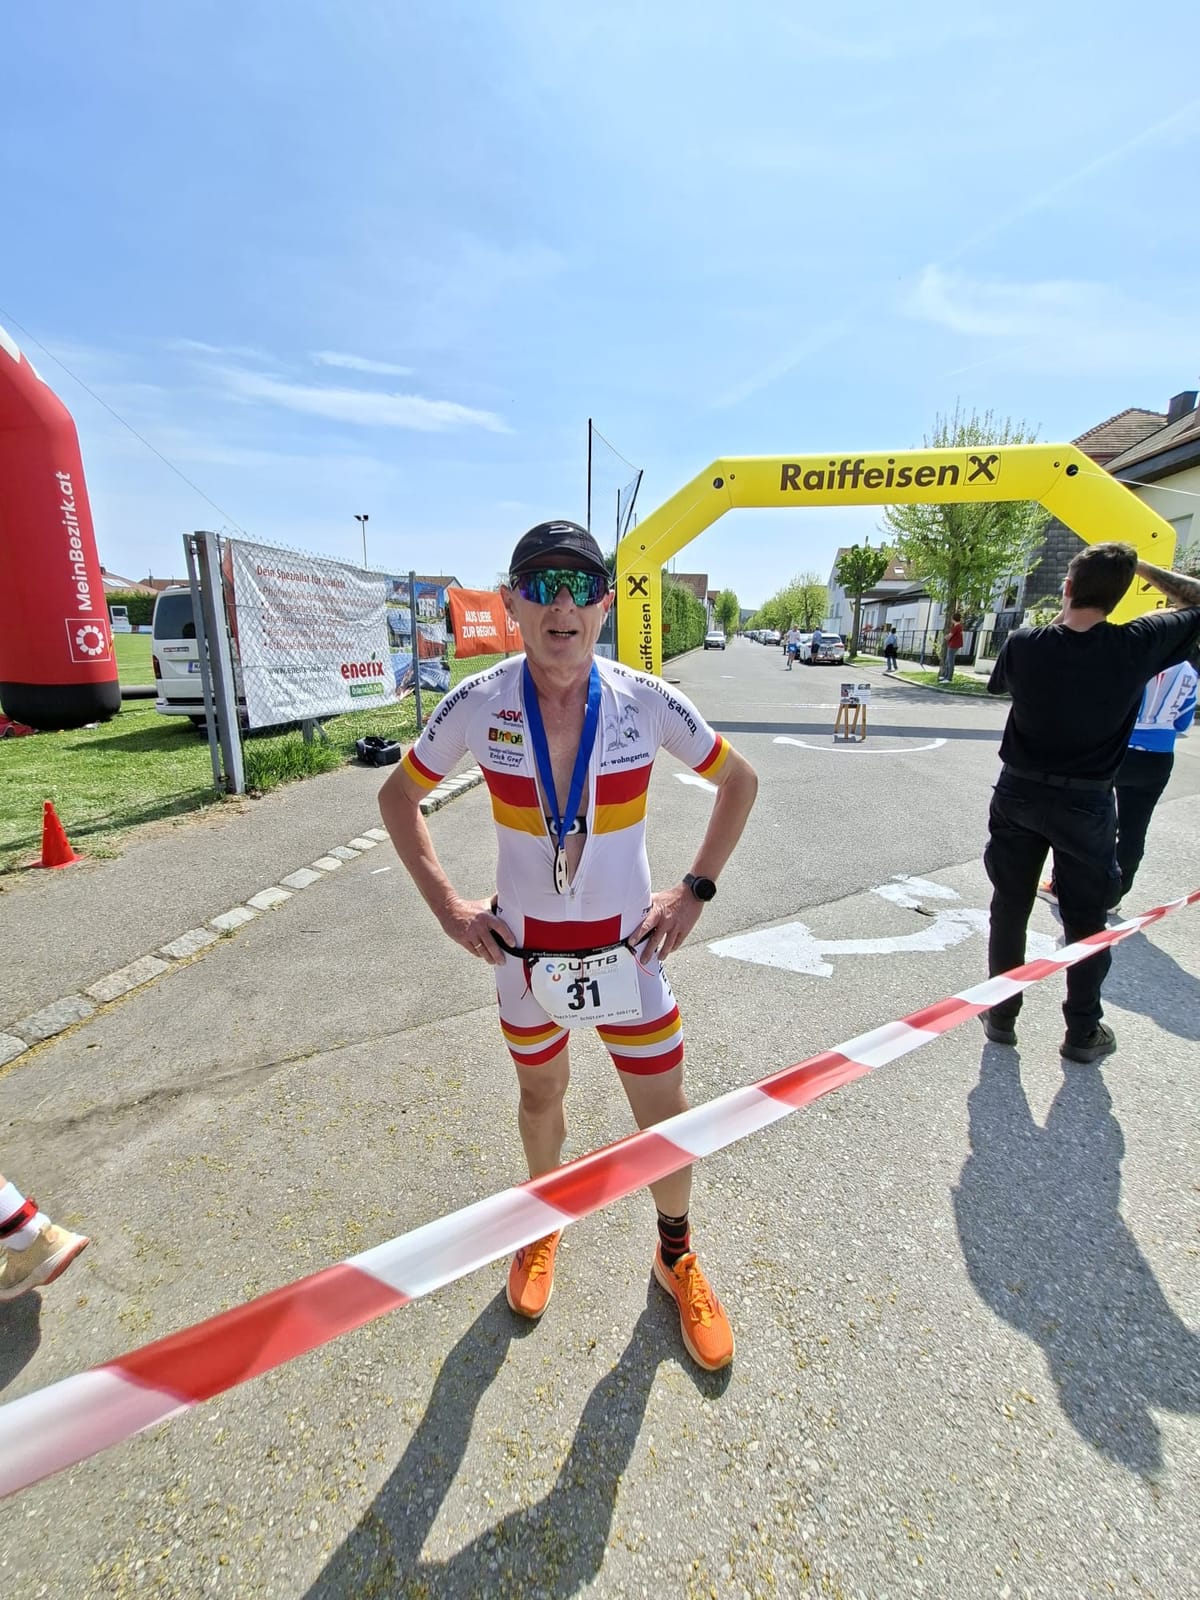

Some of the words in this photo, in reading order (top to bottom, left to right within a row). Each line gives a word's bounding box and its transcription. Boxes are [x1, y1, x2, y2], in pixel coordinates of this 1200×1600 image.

[780, 458, 960, 491] Raiffeisen
[56, 471, 93, 611] MeinBezirk.at
[465, 611, 477, 622] AUS
[462, 626, 476, 638] ZUR
[341, 661, 385, 679] enerix
[568, 954, 618, 971] UTTB
[566, 978, 601, 1011] 31
